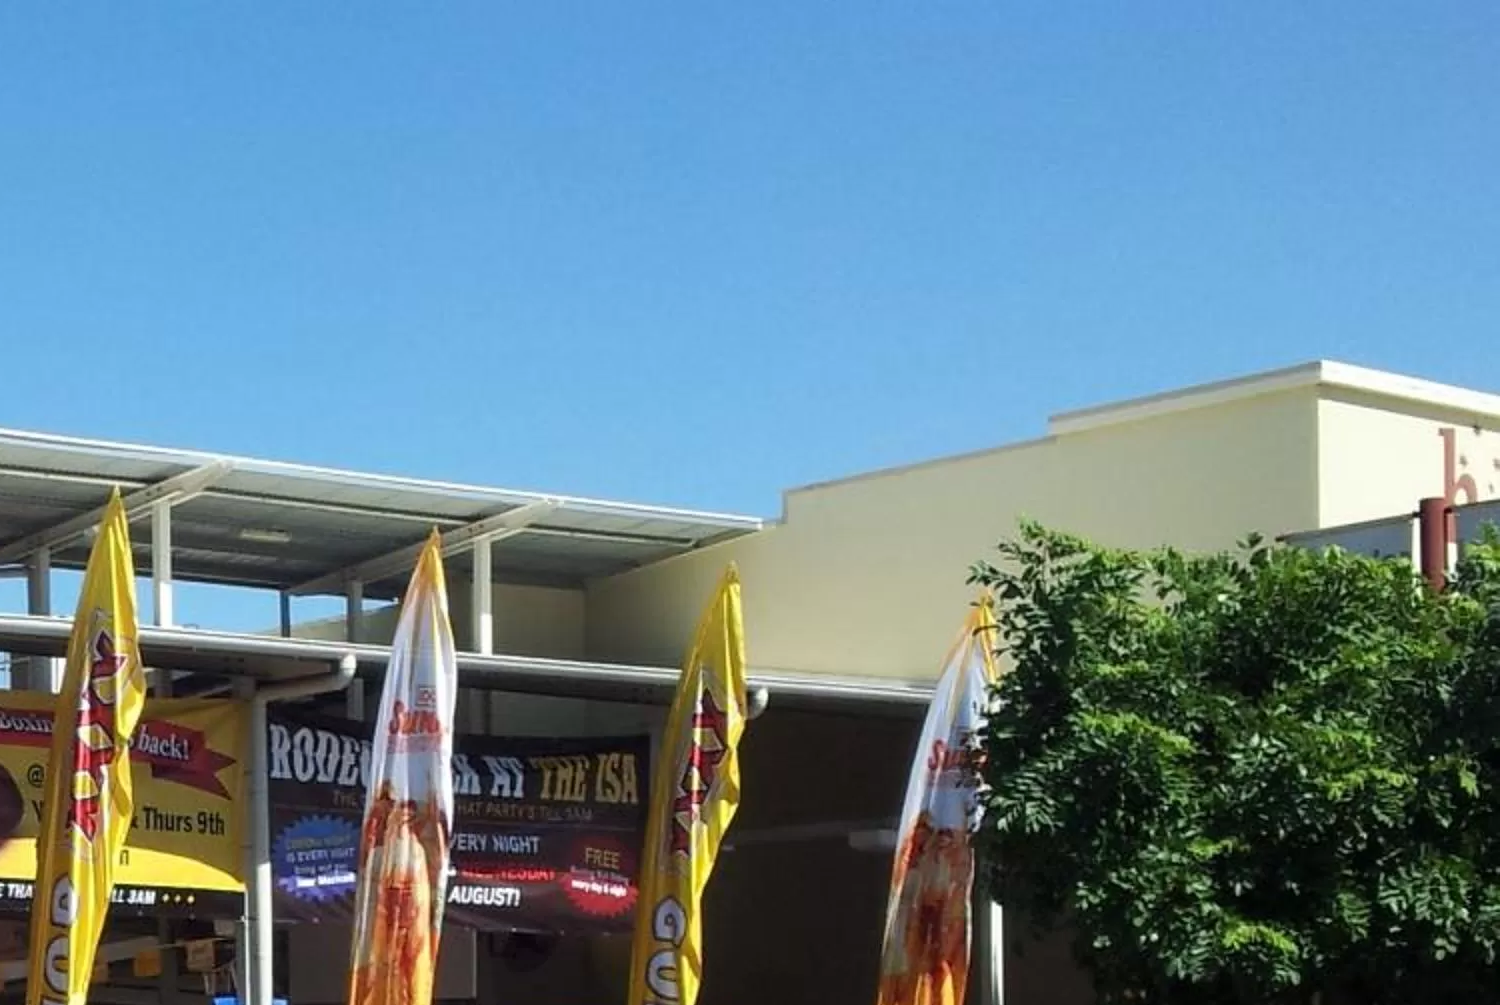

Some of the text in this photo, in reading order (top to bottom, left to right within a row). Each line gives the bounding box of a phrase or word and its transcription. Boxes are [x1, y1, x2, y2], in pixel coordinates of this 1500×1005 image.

[138, 724, 190, 760] back!
[481, 755, 525, 798] AT
[529, 754, 590, 801] THE
[594, 753, 639, 804] ISA
[143, 805, 193, 833] Thurs
[197, 811, 225, 836] 9th
[449, 833, 541, 854] VERY NIGHT
[585, 847, 620, 870] FREE
[7, 883, 34, 899] THA
[448, 885, 521, 907] AUGUST!
